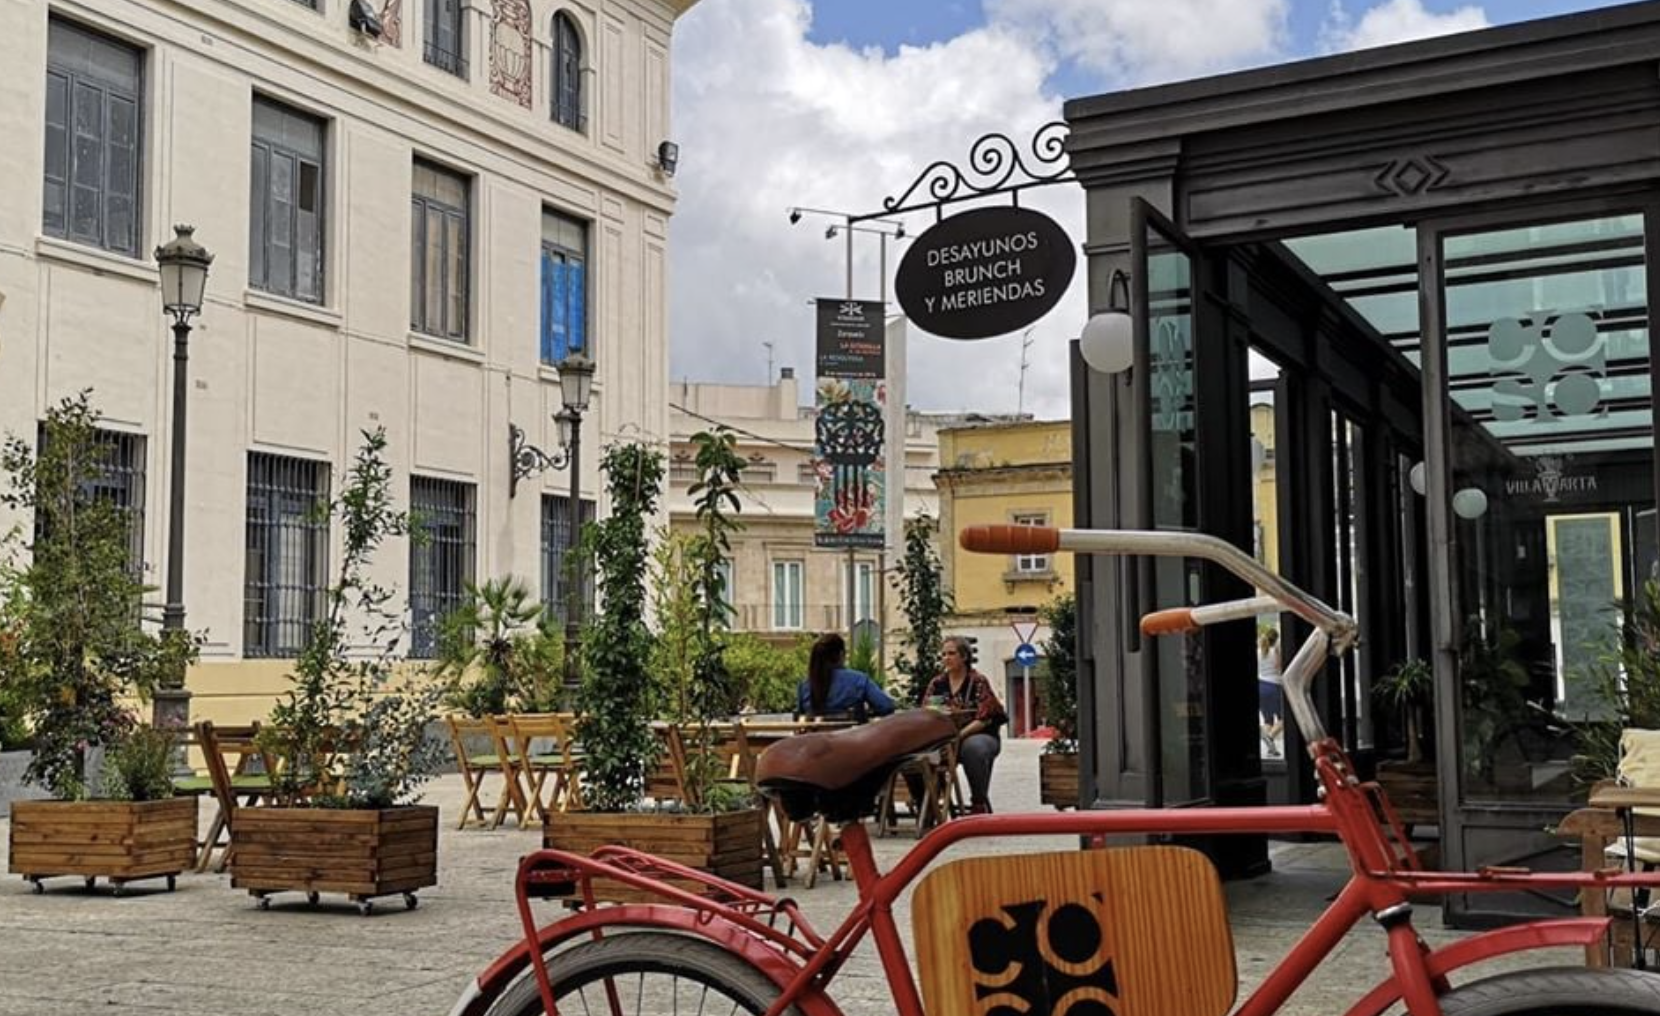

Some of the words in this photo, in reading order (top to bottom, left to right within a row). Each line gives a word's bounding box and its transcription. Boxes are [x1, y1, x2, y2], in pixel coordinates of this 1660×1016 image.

[927, 232, 1038, 266] DESAYUNOS
[944, 259, 1021, 287] BRUNCH
[925, 297, 937, 313] Y
[941, 278, 1046, 311] MERIENDAS
